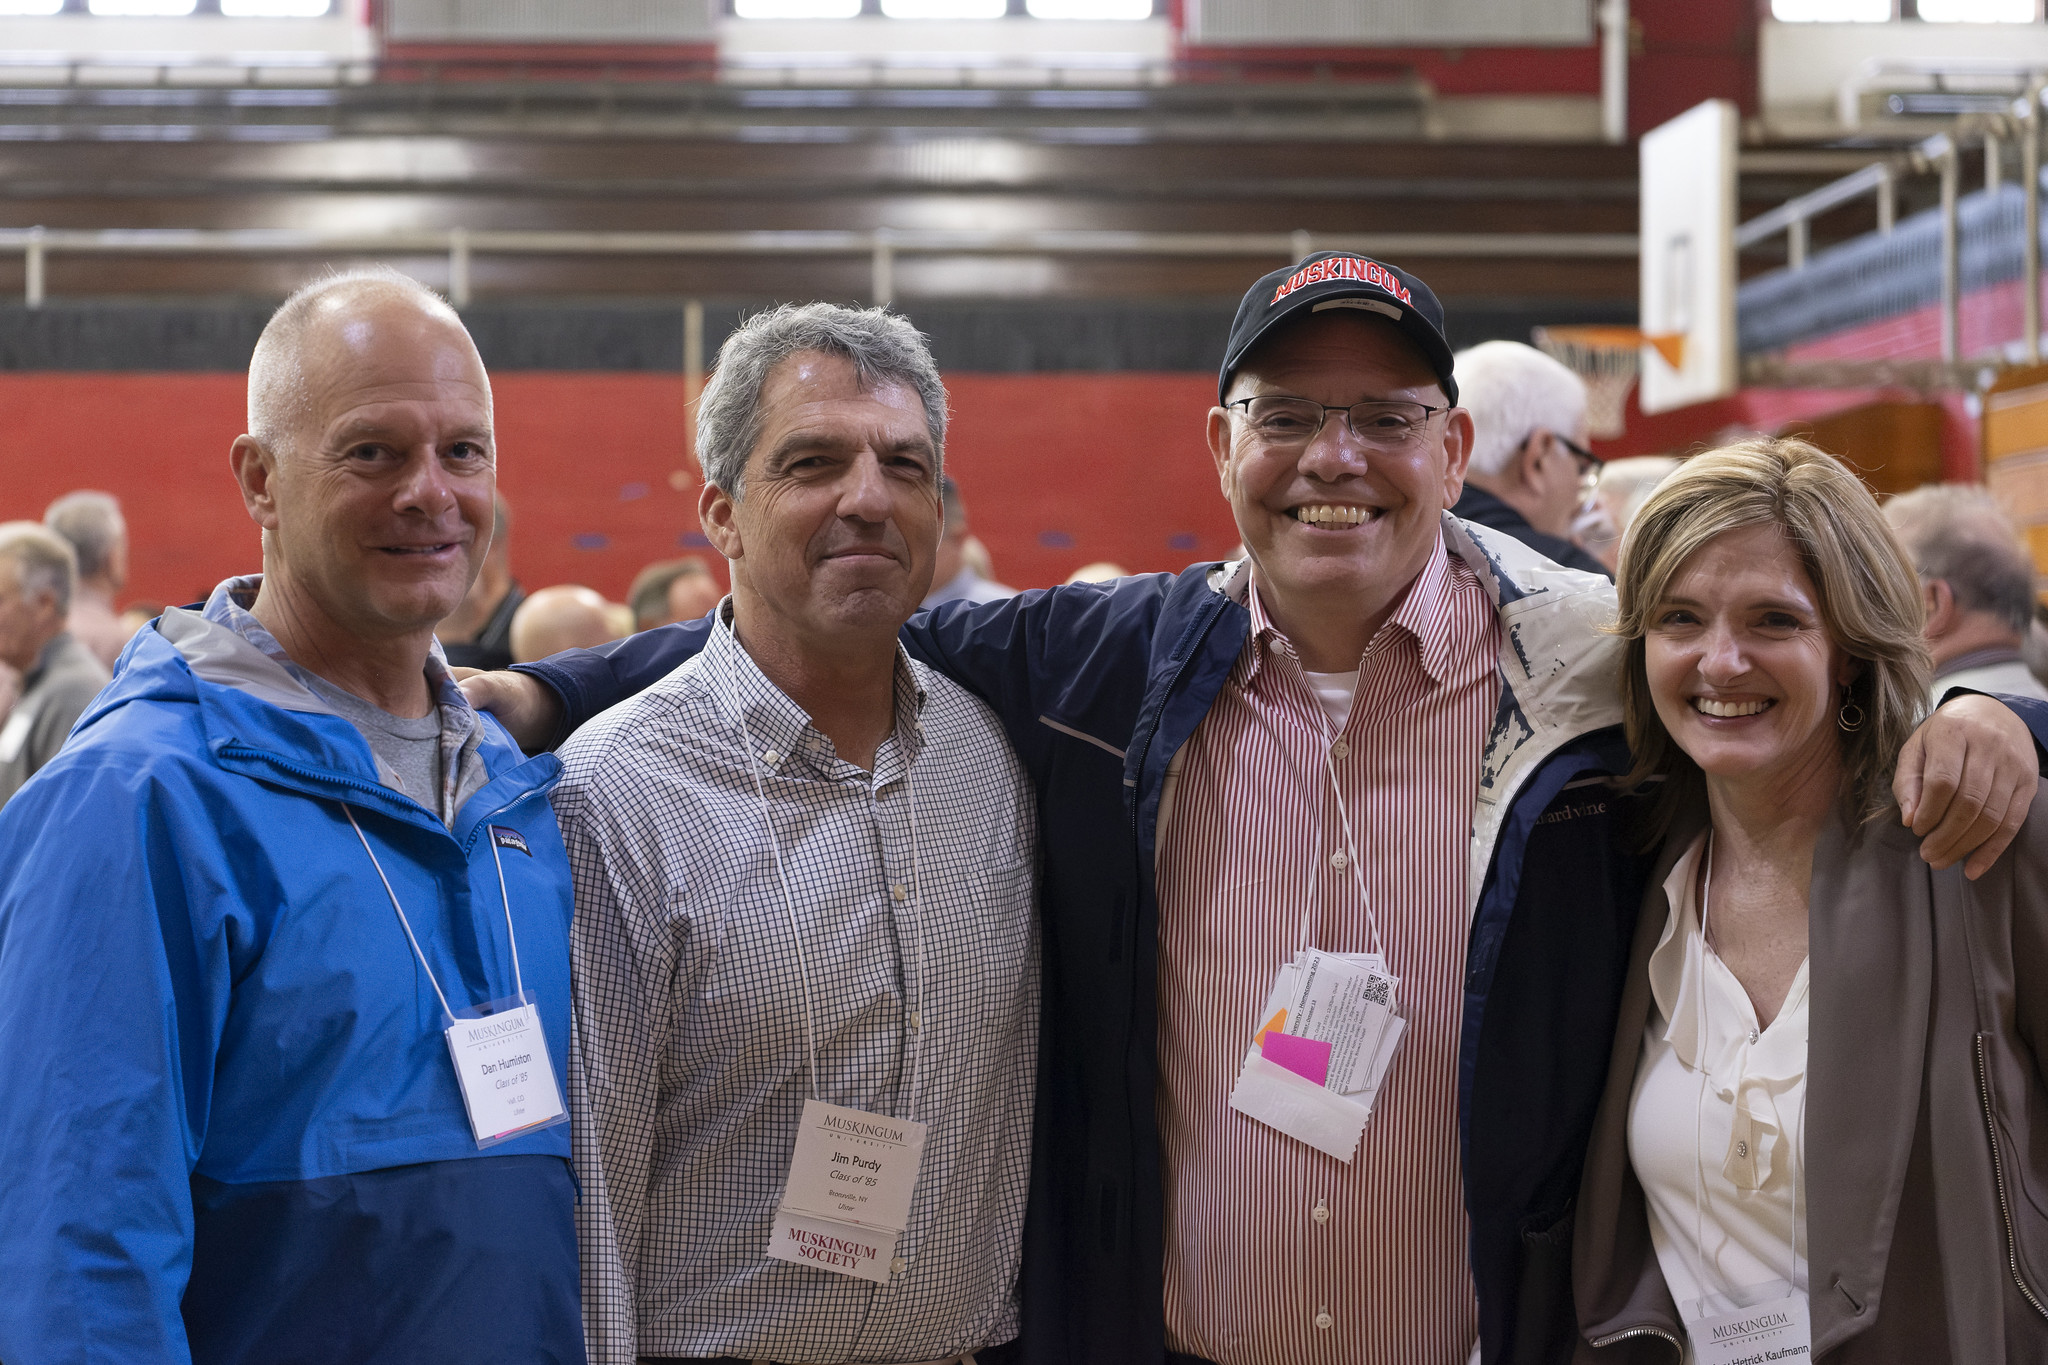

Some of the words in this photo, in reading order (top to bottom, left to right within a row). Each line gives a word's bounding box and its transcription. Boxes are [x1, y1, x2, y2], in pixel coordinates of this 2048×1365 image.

[1269, 257, 1415, 308] MUSKINGUM
[1290, 1013, 1303, 1036] niversity
[1299, 971, 1316, 1009] Homecoming
[469, 1018, 525, 1042] MUSKINGUM
[481, 1062, 497, 1075] Dan
[498, 1053, 531, 1071] Humiston
[495, 1078, 510, 1089] Class
[511, 1075, 519, 1086] of
[824, 1115, 903, 1141] MUSKINGUM
[829, 1134, 893, 1149] UNIVERSITY
[831, 1152, 849, 1164] Jim
[852, 1156, 881, 1172] Purdy
[830, 1170, 851, 1183] Class
[852, 1175, 864, 1184] of
[865, 1176, 878, 1187] '85
[788, 1228, 877, 1260] MUSKINGUM
[798, 1245, 860, 1269] SOCIETY
[1713, 1312, 1788, 1339] MUSKINGUM
[1732, 1354, 1763, 1365] Hetrick
[1765, 1344, 1810, 1361] Kaufmann
